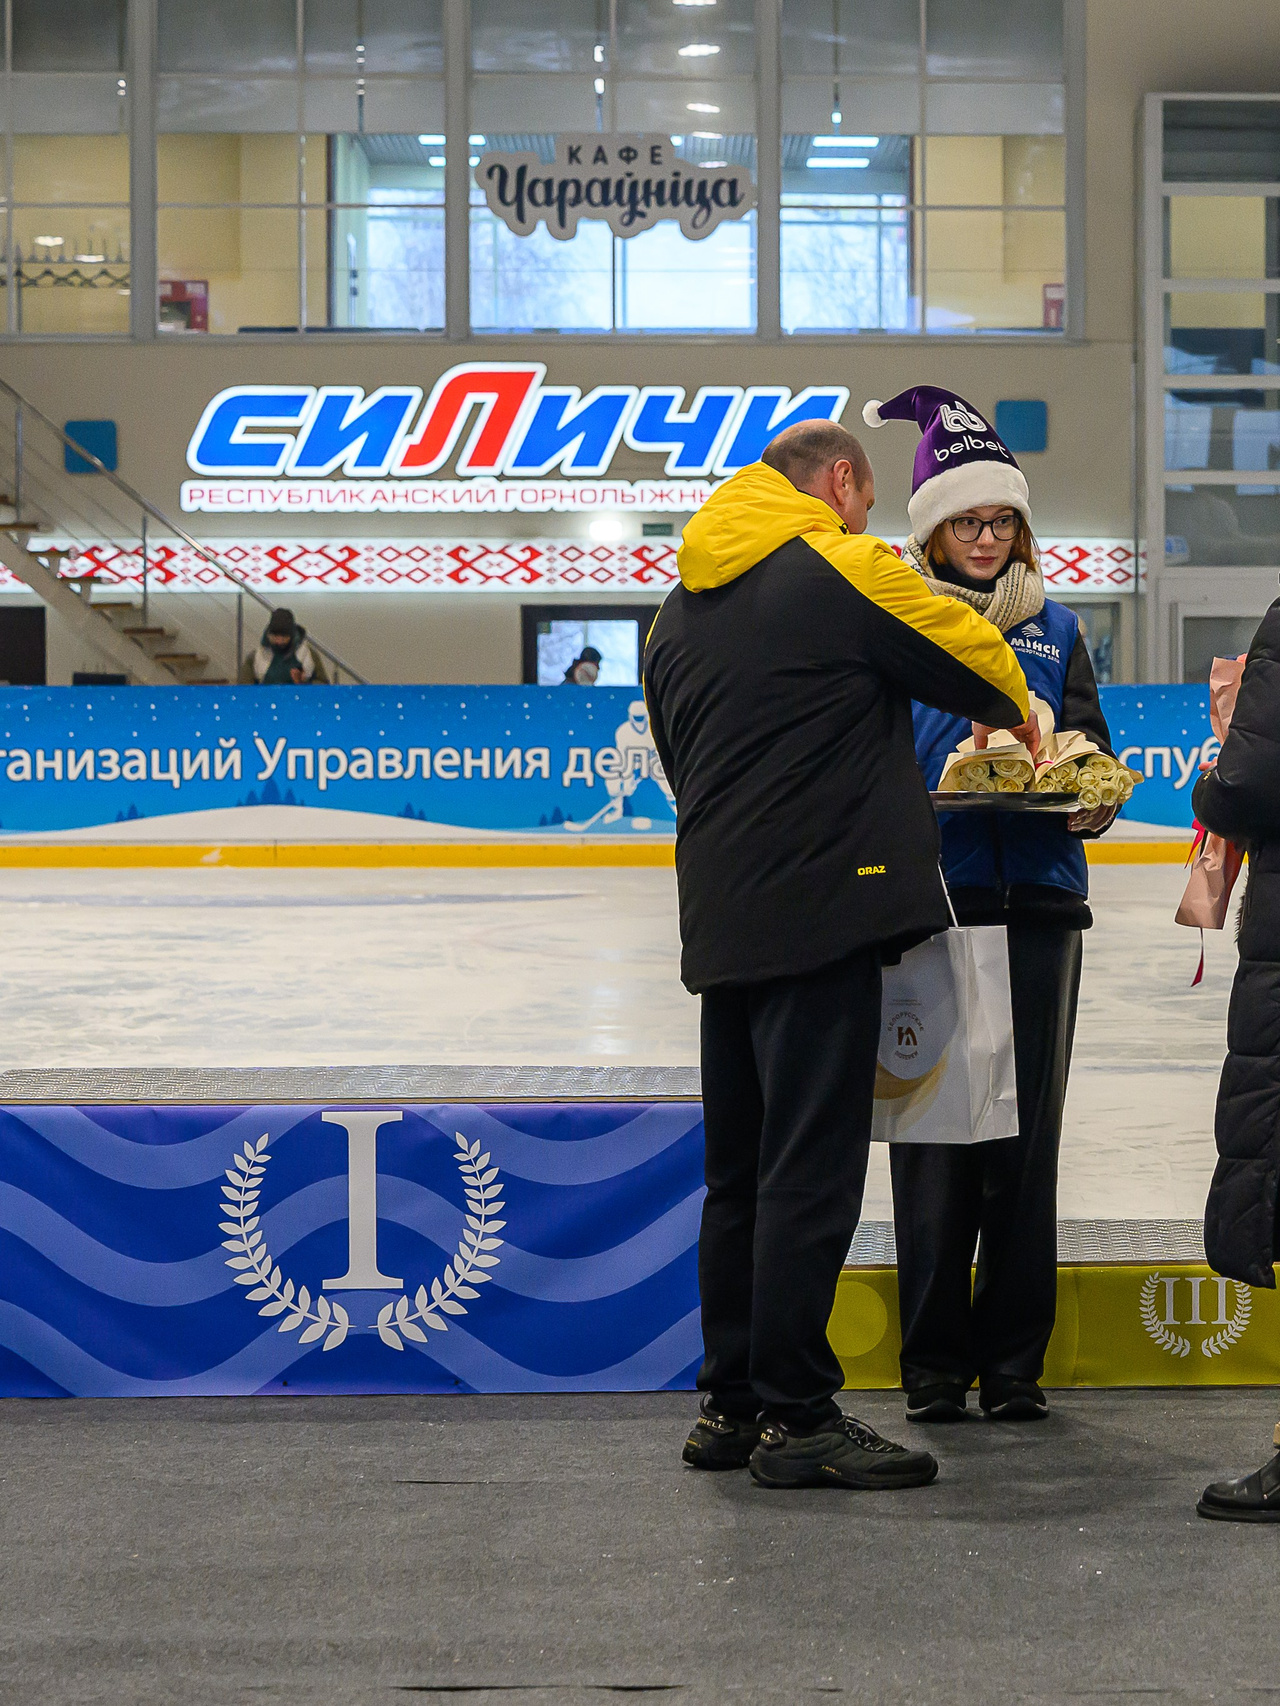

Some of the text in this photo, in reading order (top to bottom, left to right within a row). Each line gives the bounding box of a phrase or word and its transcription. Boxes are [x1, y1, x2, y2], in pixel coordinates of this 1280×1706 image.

[568, 144, 663, 166] КАФЕ
[486, 163, 745, 230] Чараўніца
[933, 434, 1010, 462] belbet
[188, 485, 497, 505] РЕСПУБЛИКАНСКИЙ
[253, 736, 551, 791] Управления
[857, 865, 887, 876] ORAZ
[1159, 1277, 1234, 1325] III
